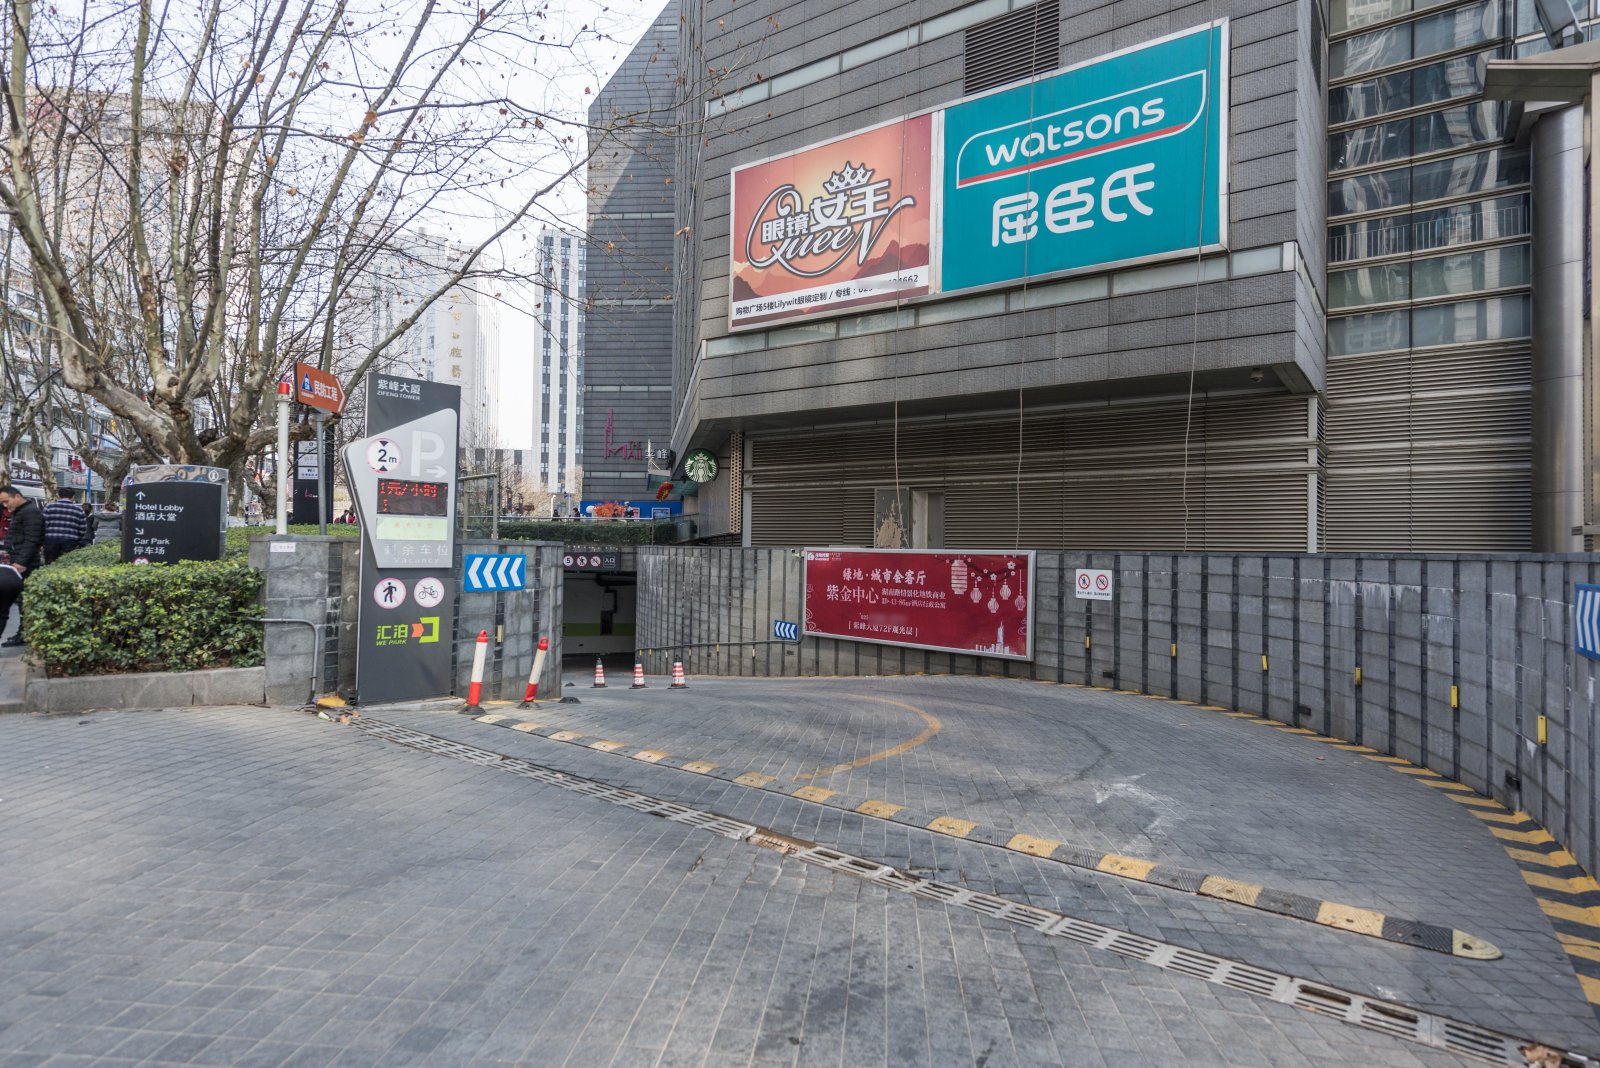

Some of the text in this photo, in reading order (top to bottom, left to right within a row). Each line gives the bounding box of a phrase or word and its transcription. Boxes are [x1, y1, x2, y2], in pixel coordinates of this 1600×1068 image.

[985, 97, 1165, 166] watsons
[991, 162, 1156, 248] 屈臣氏
[377, 379, 421, 395] 紫峰大厦
[377, 390, 421, 401] ZIFENG TOWER
[411, 430, 445, 477] P
[135, 503, 184, 513] Hotel Lobby
[135, 512, 177, 522] 酒店大堂
[133, 546, 165, 555] 停车场
[826, 584, 879, 604] 紫金中心
[376, 624, 409, 640] 汇泊
